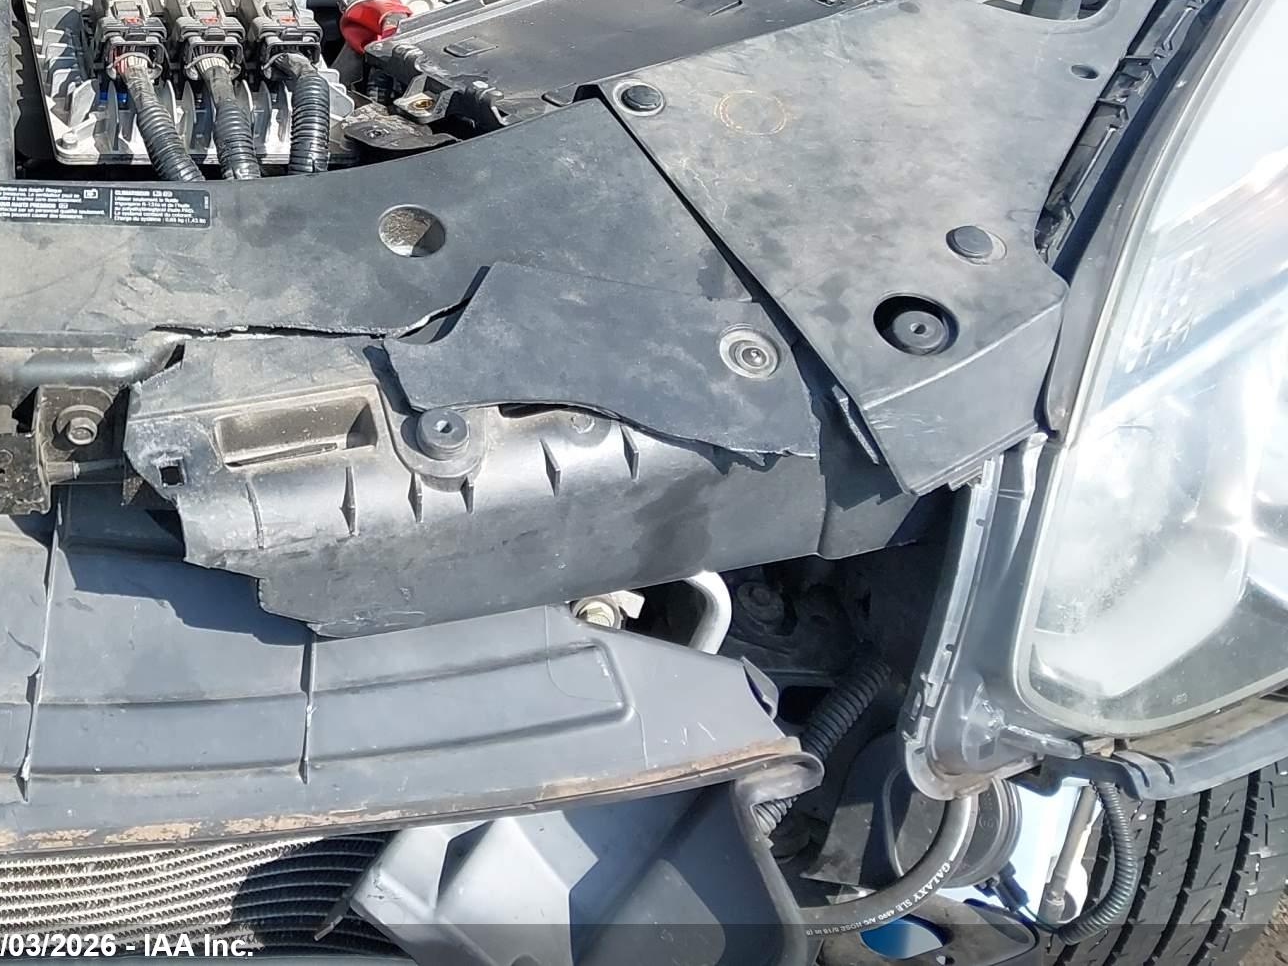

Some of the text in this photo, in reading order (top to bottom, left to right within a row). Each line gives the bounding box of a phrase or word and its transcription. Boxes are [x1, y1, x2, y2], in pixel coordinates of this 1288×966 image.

[913, 862, 951, 902] GALAXY
[896, 898, 913, 912] SLE
[840, 921, 862, 932] HOSE
